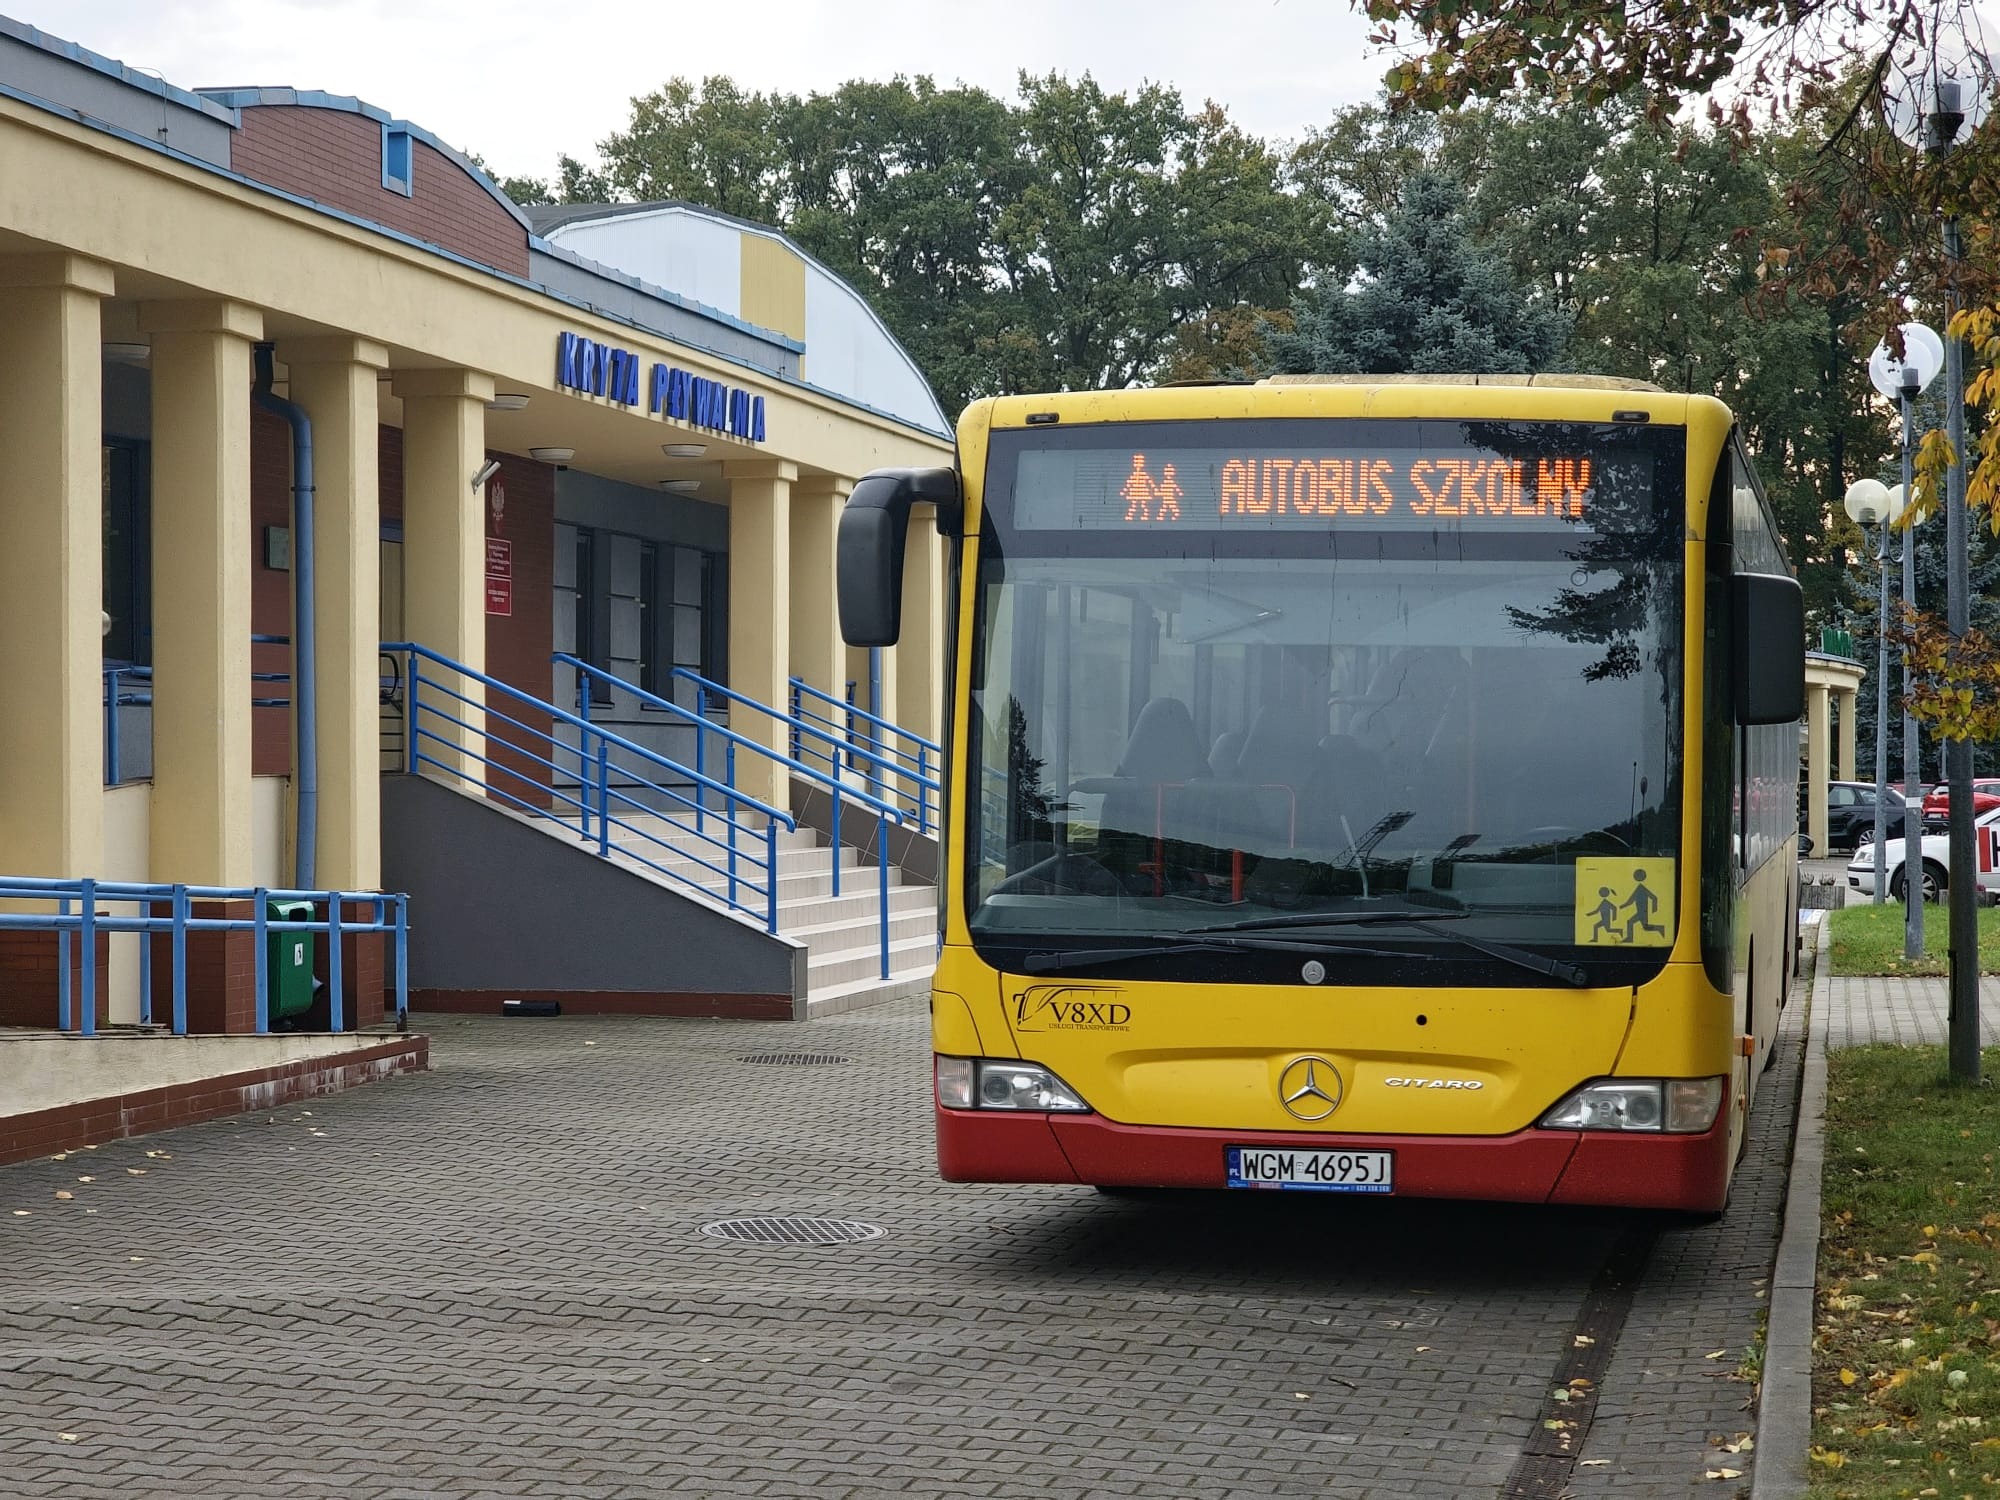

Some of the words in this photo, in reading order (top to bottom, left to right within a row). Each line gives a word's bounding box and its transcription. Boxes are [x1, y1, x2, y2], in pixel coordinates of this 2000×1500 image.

[558, 331, 639, 406] KRYTA
[650, 363, 766, 442] PŁYWALNIA
[1220, 459, 1393, 515] AUTOBUS
[1409, 459, 1592, 516] SZKOLNY
[1049, 1002, 1131, 1025] V8XD
[1384, 1077, 1483, 1090] CITARO
[1229, 1168, 1240, 1176] PL
[1243, 1153, 1294, 1180] WGM
[1304, 1155, 1385, 1183] 4695J
